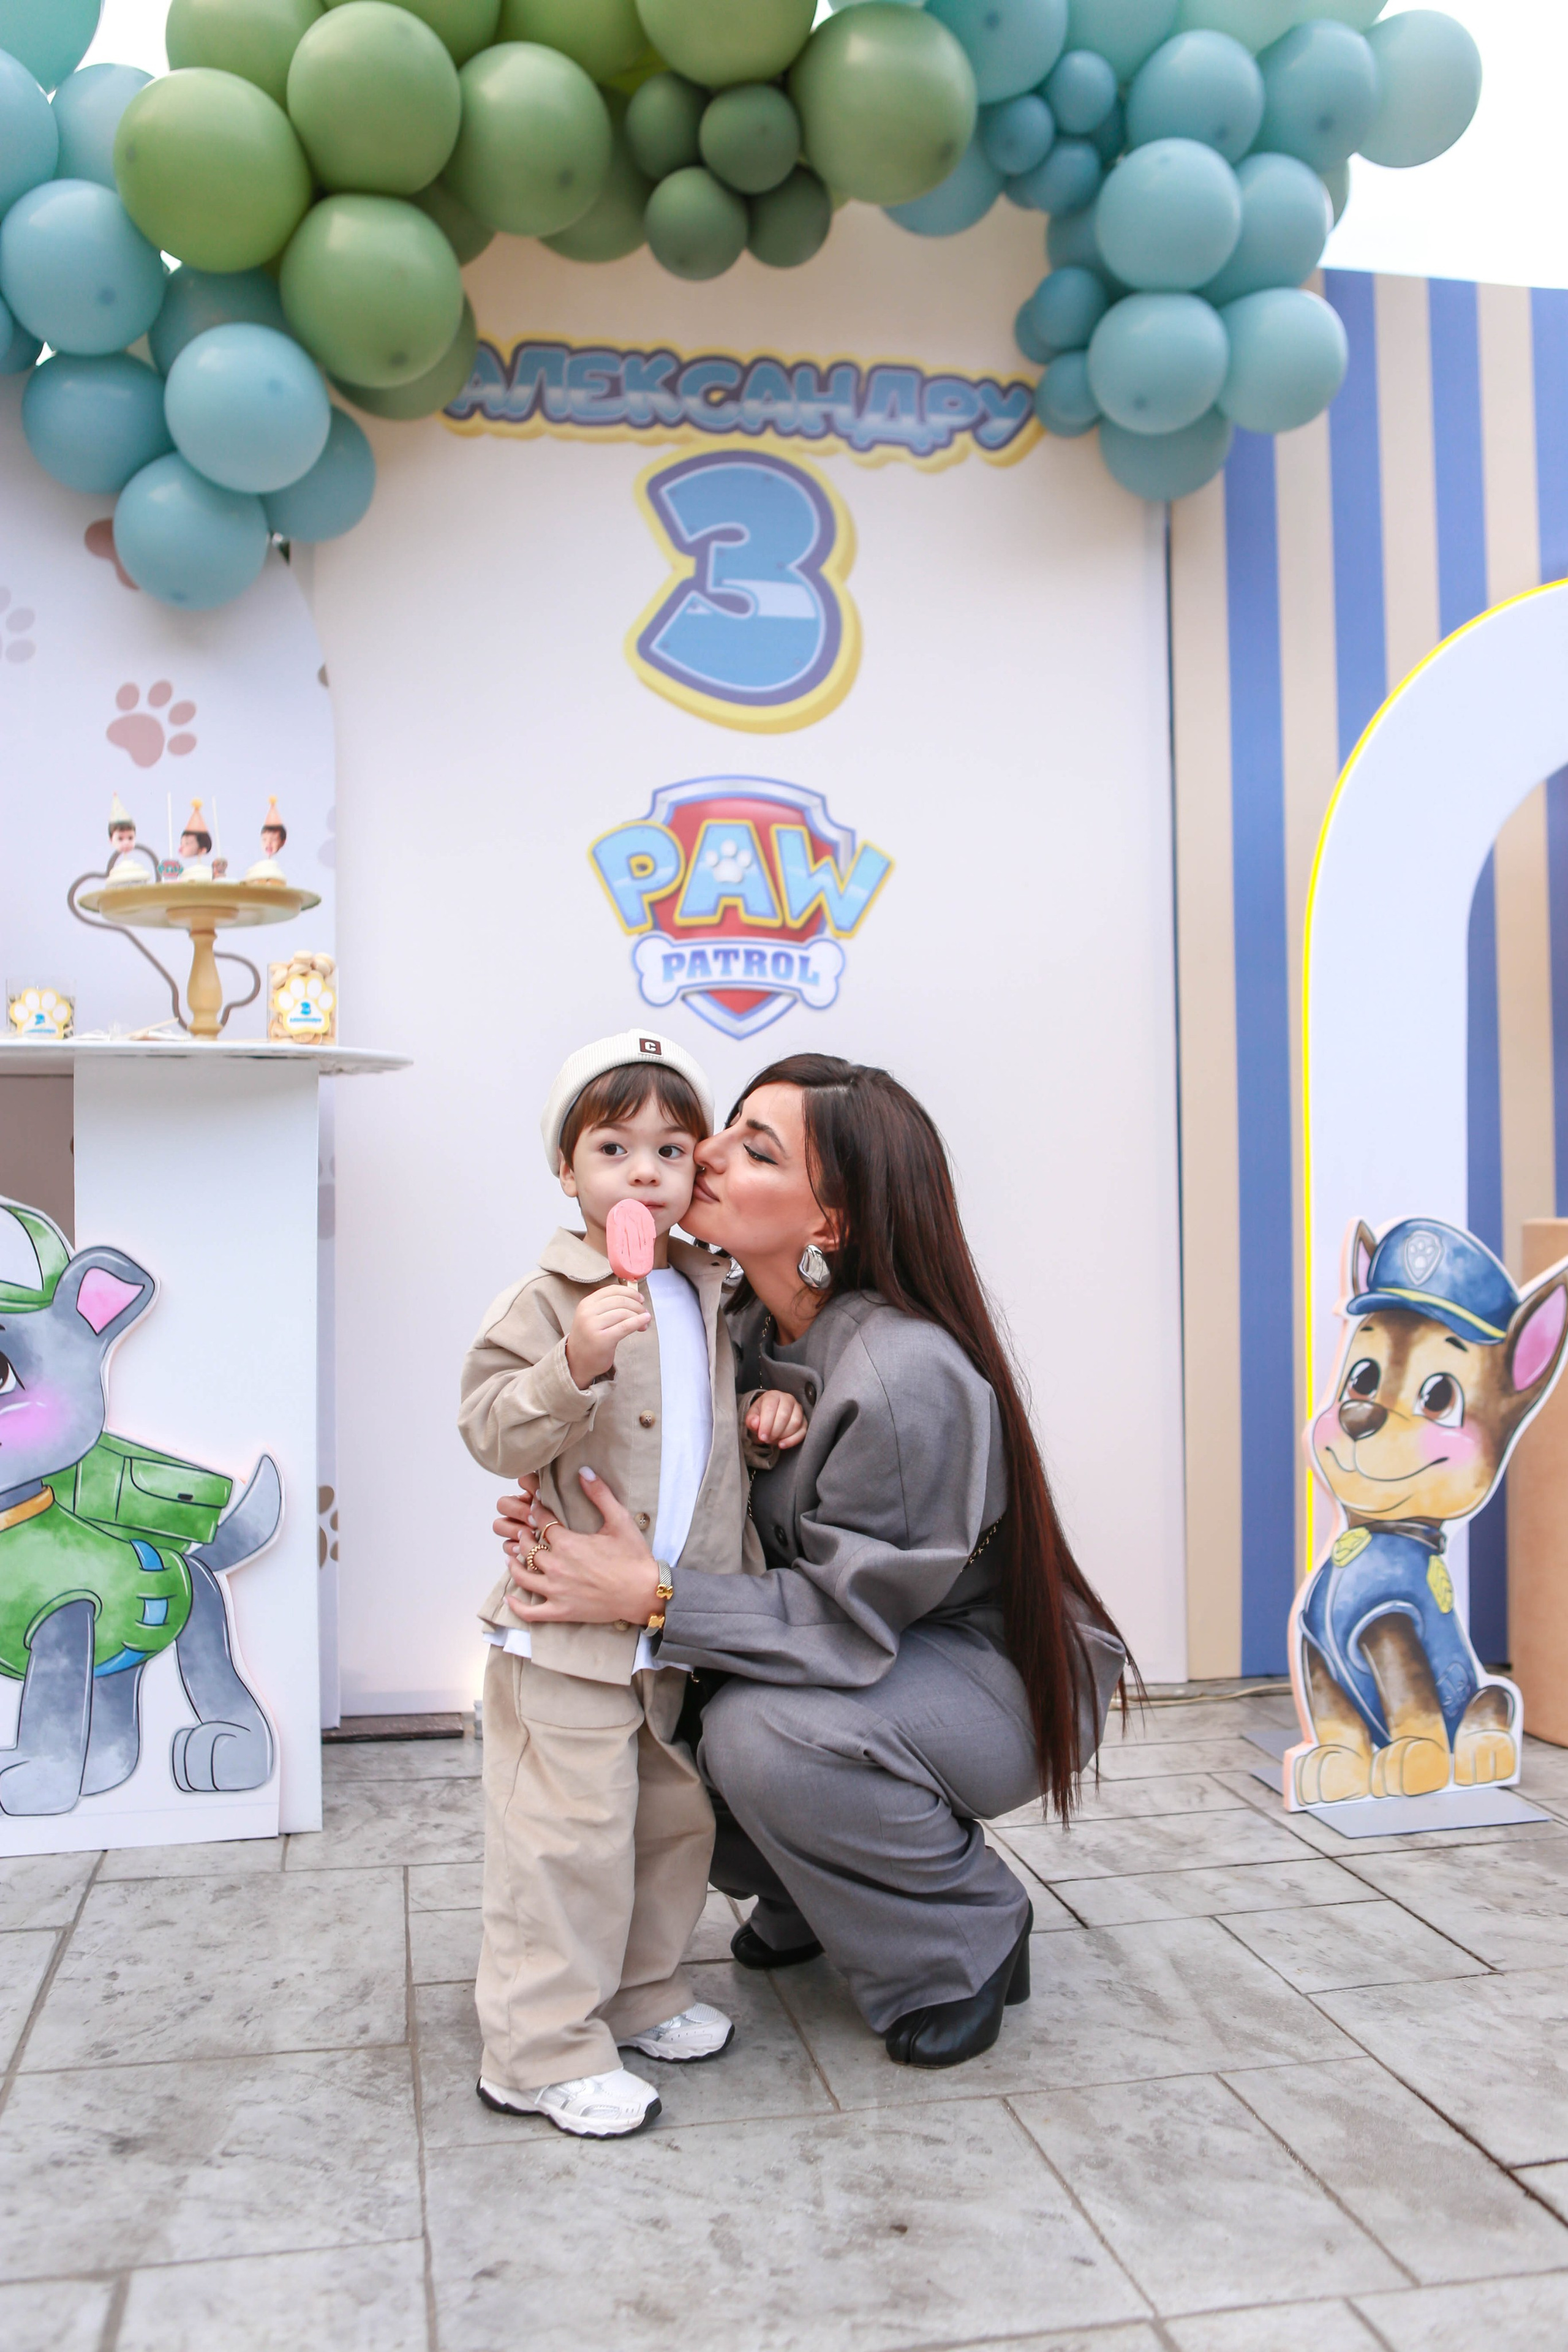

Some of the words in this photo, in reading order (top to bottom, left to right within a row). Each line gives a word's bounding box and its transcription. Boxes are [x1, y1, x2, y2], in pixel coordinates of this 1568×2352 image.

[443, 340, 1035, 457] АЛЕКСАНДРУ
[636, 448, 843, 706] 3
[587, 819, 895, 938] PAW
[662, 948, 820, 987] PATROL
[644, 1041, 657, 1052] C
